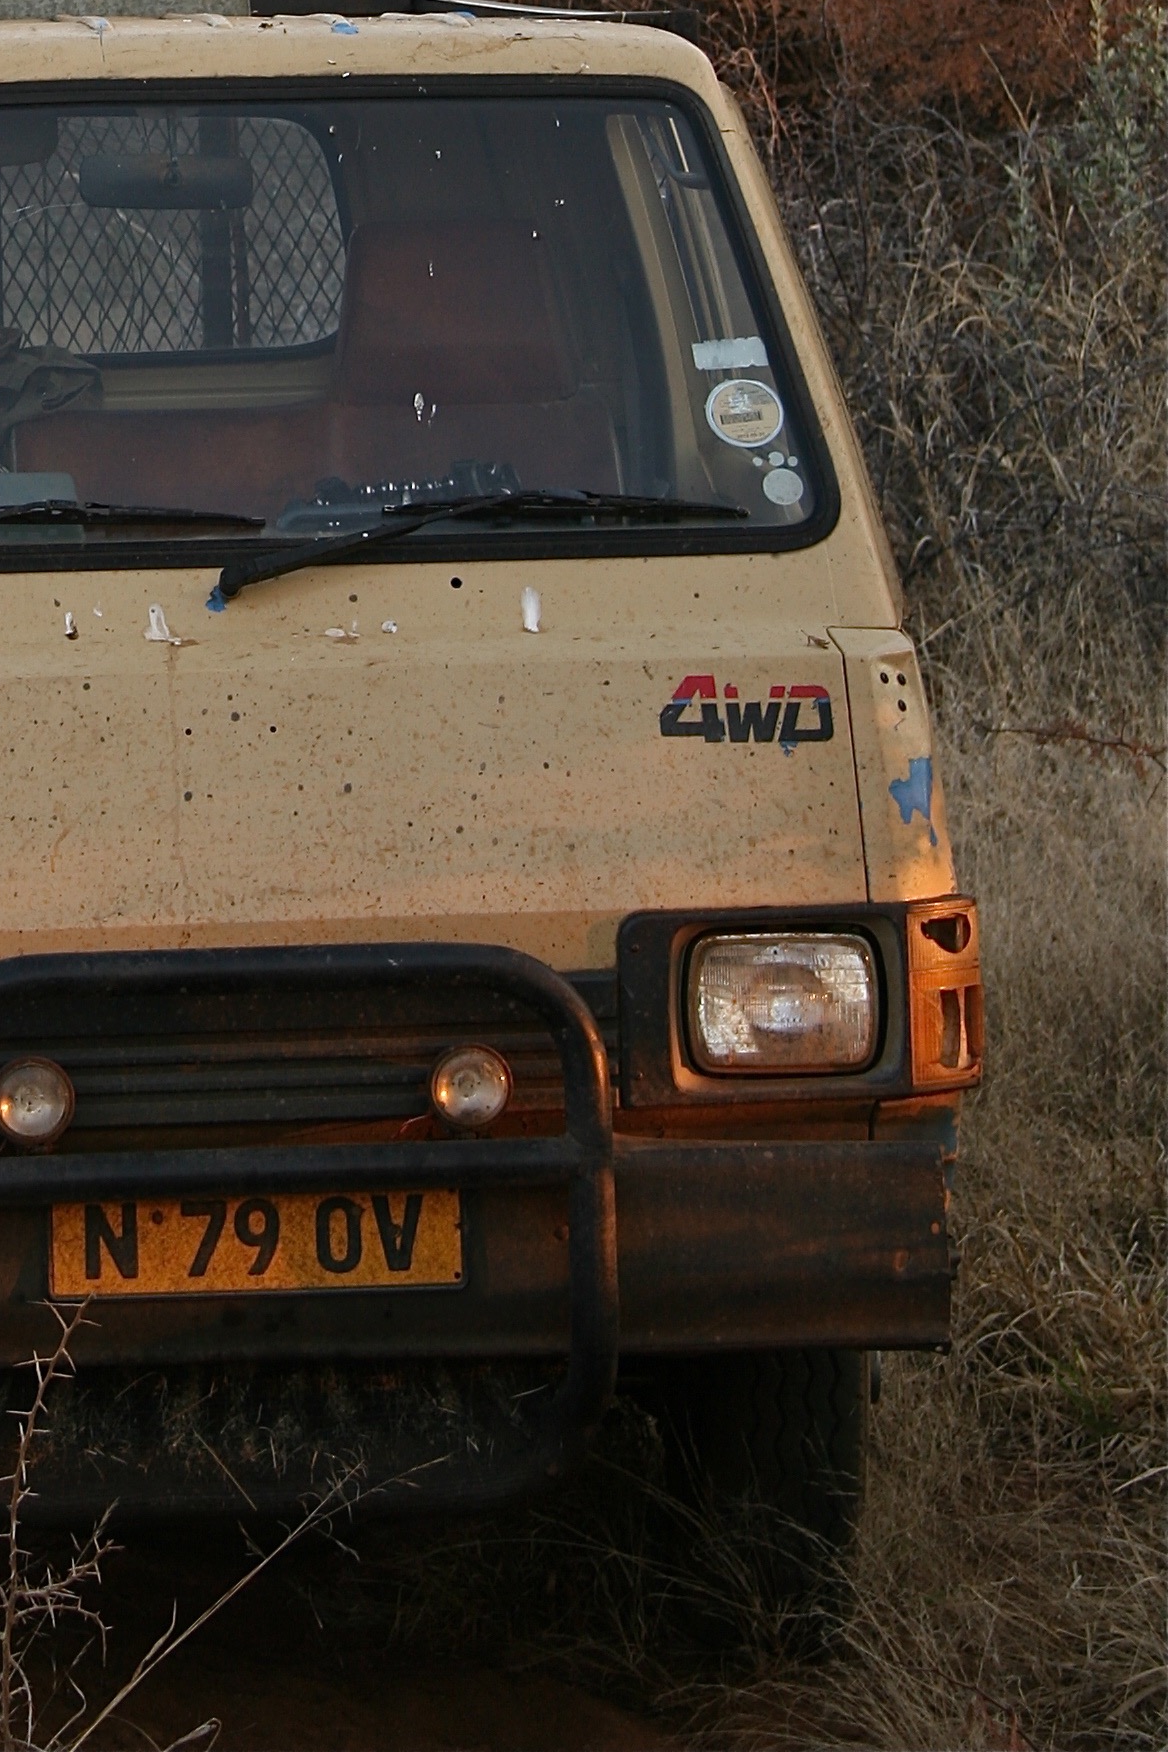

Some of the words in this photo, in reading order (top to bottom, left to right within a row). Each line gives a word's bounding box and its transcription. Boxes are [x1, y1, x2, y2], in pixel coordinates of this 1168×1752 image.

[659, 674, 834, 743] 4WD
[84, 1203, 139, 1280] N
[180, 1197, 281, 1278] 79
